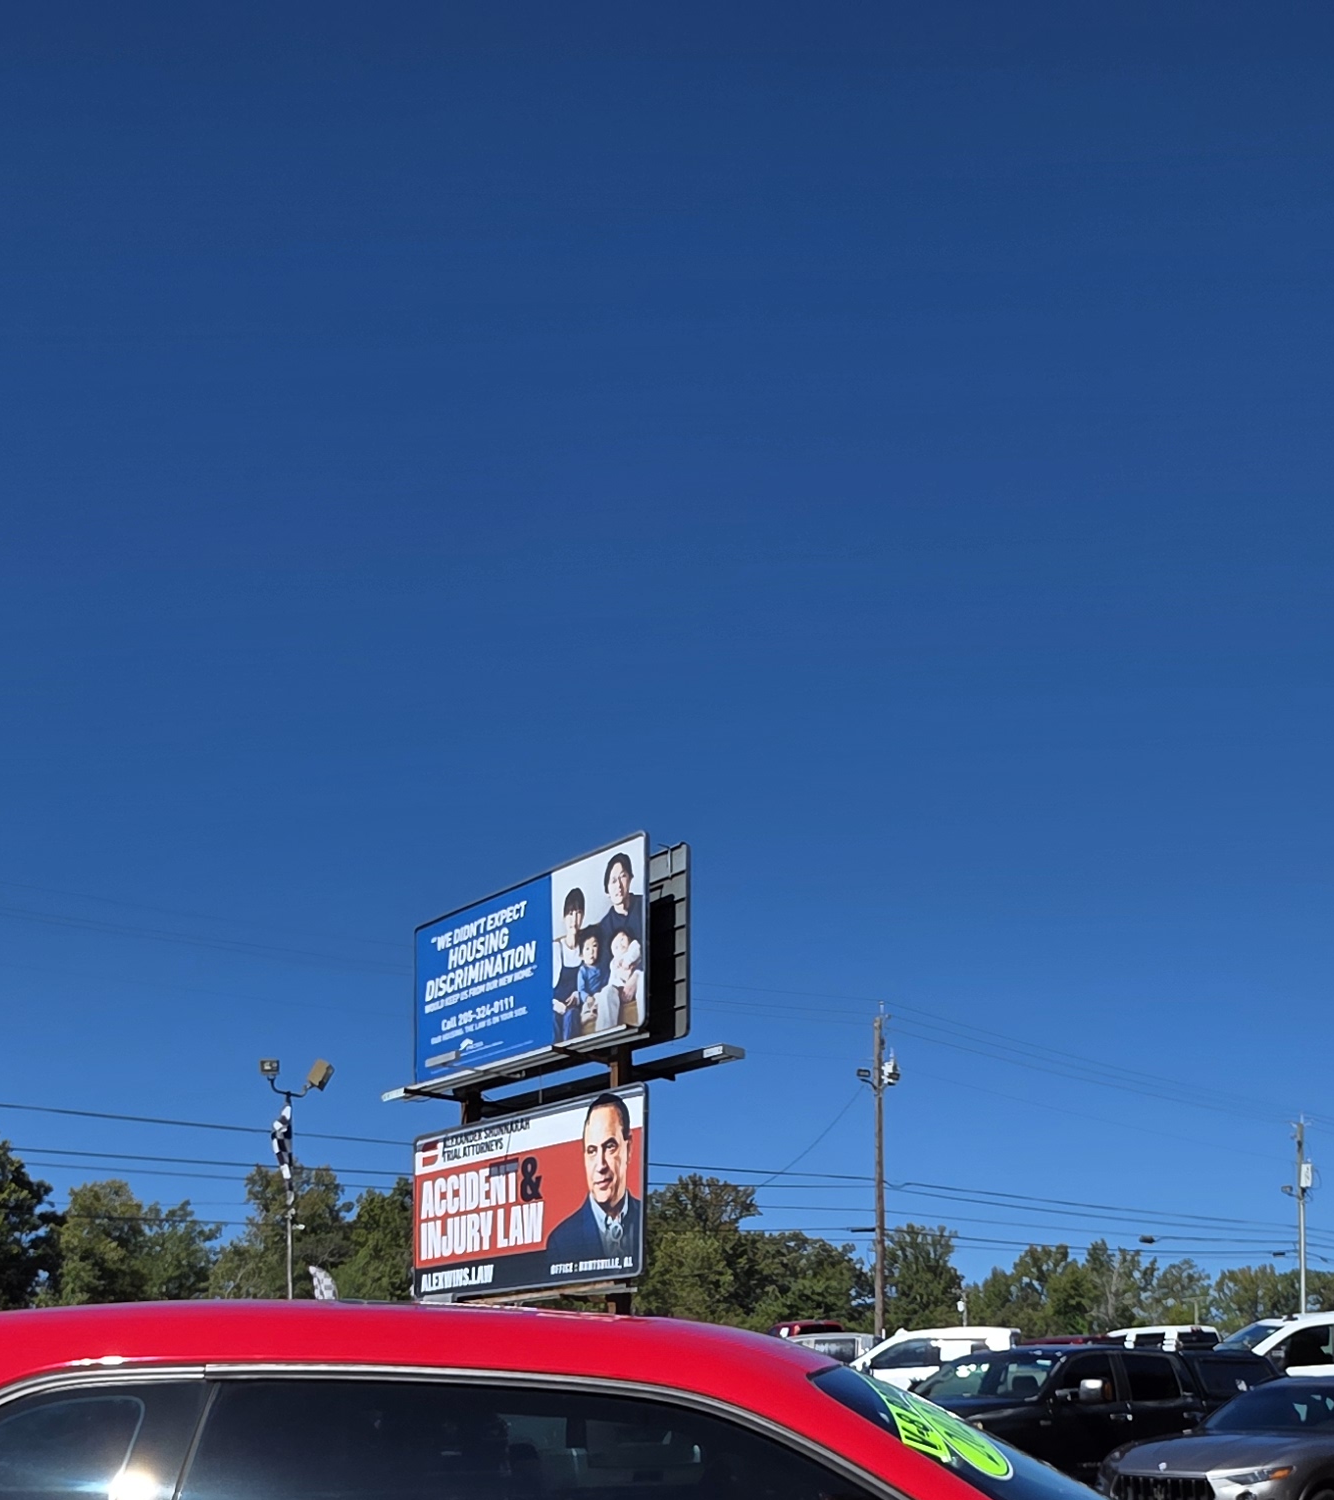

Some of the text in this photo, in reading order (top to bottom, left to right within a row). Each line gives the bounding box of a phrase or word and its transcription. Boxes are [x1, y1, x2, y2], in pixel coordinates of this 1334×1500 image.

[453, 917, 487, 945] DIDN'T
[487, 900, 527, 931] EXPECT
[448, 927, 509, 970] HOUSING
[425, 941, 536, 1002] DISCRIMINATION
[441, 1016, 457, 1032] Call
[462, 1138, 504, 1158] ATTORNEYS
[420, 1156, 543, 1220] ACCIDENT &
[420, 1201, 544, 1261] INJURY LAW
[420, 1264, 494, 1293] ALEXWINS.LAW
[550, 1262, 573, 1275] OFFICE
